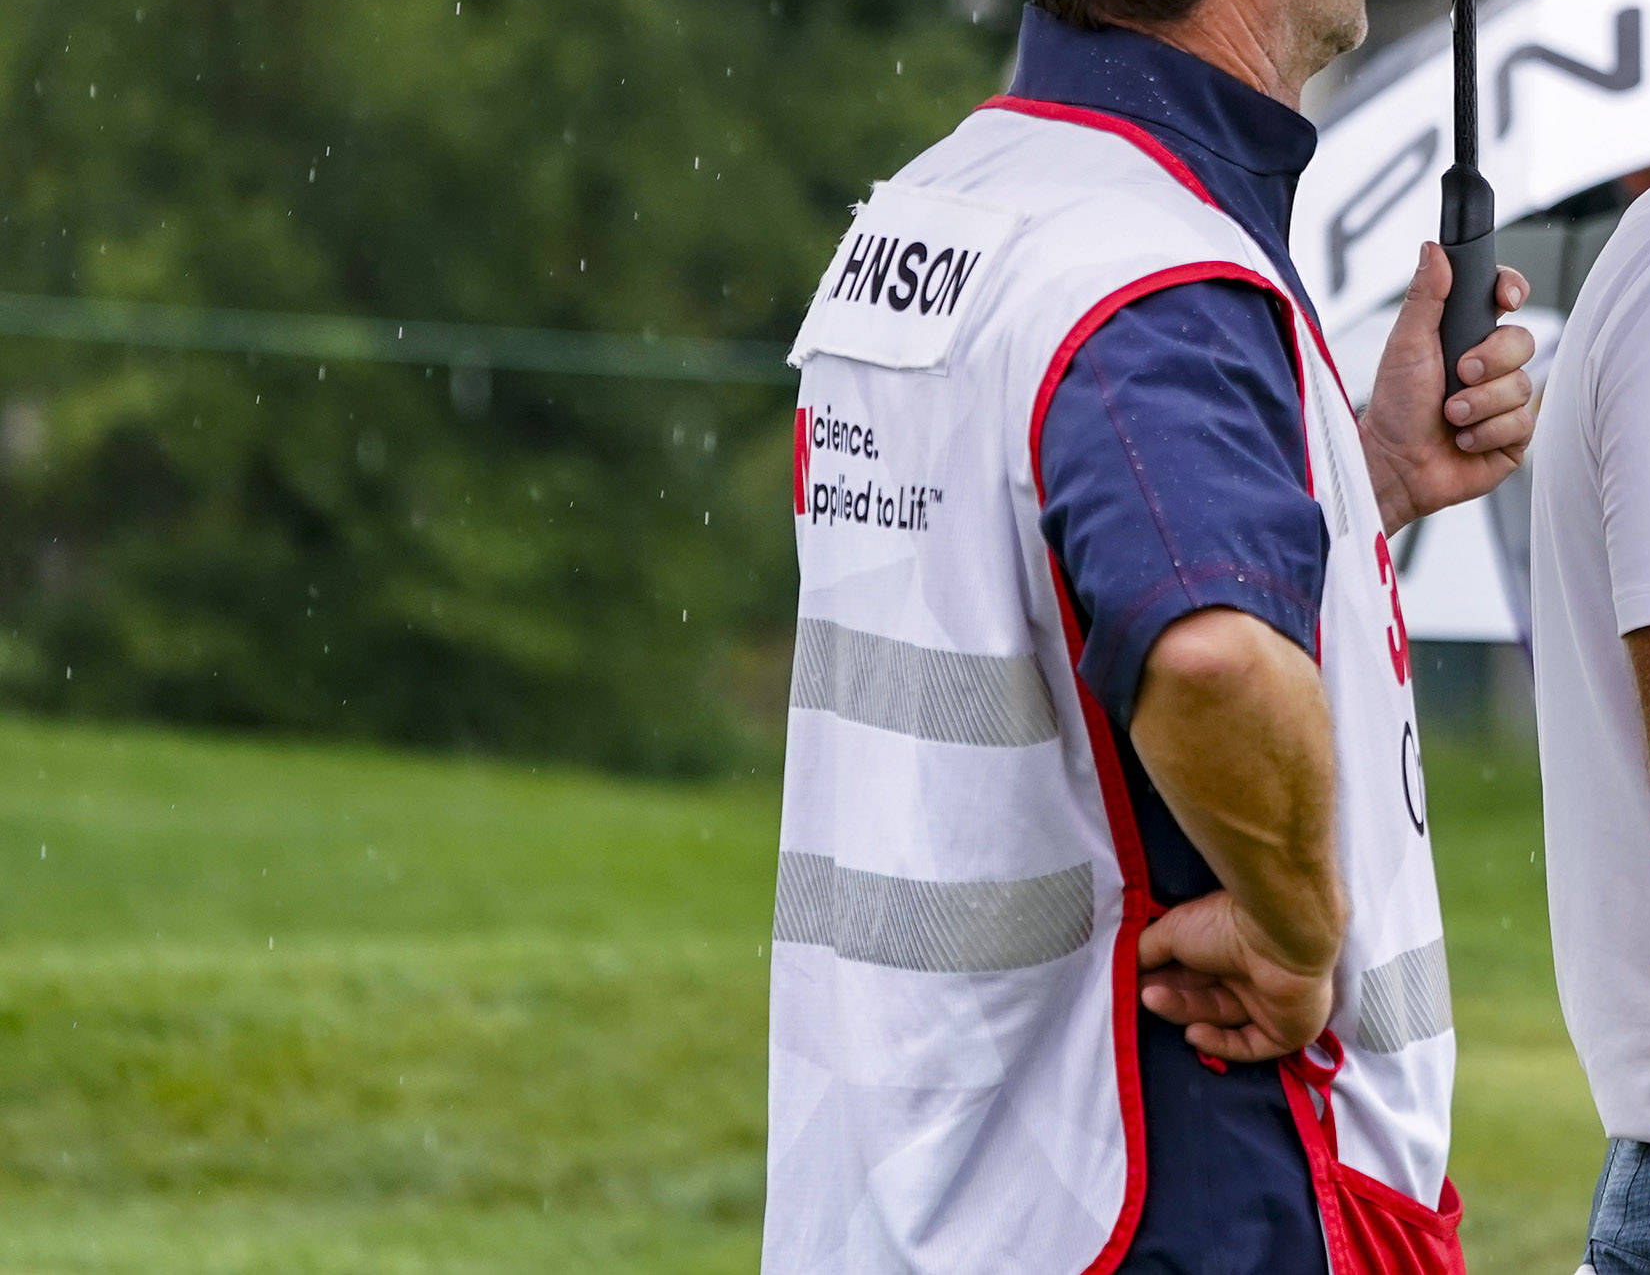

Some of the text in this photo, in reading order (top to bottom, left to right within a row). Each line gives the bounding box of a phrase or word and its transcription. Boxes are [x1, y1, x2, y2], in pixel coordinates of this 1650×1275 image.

[826, 233, 982, 316] HNSON
[812, 404, 879, 460] cience.
[807, 474, 872, 527] pplied
[876, 488, 895, 528] to
